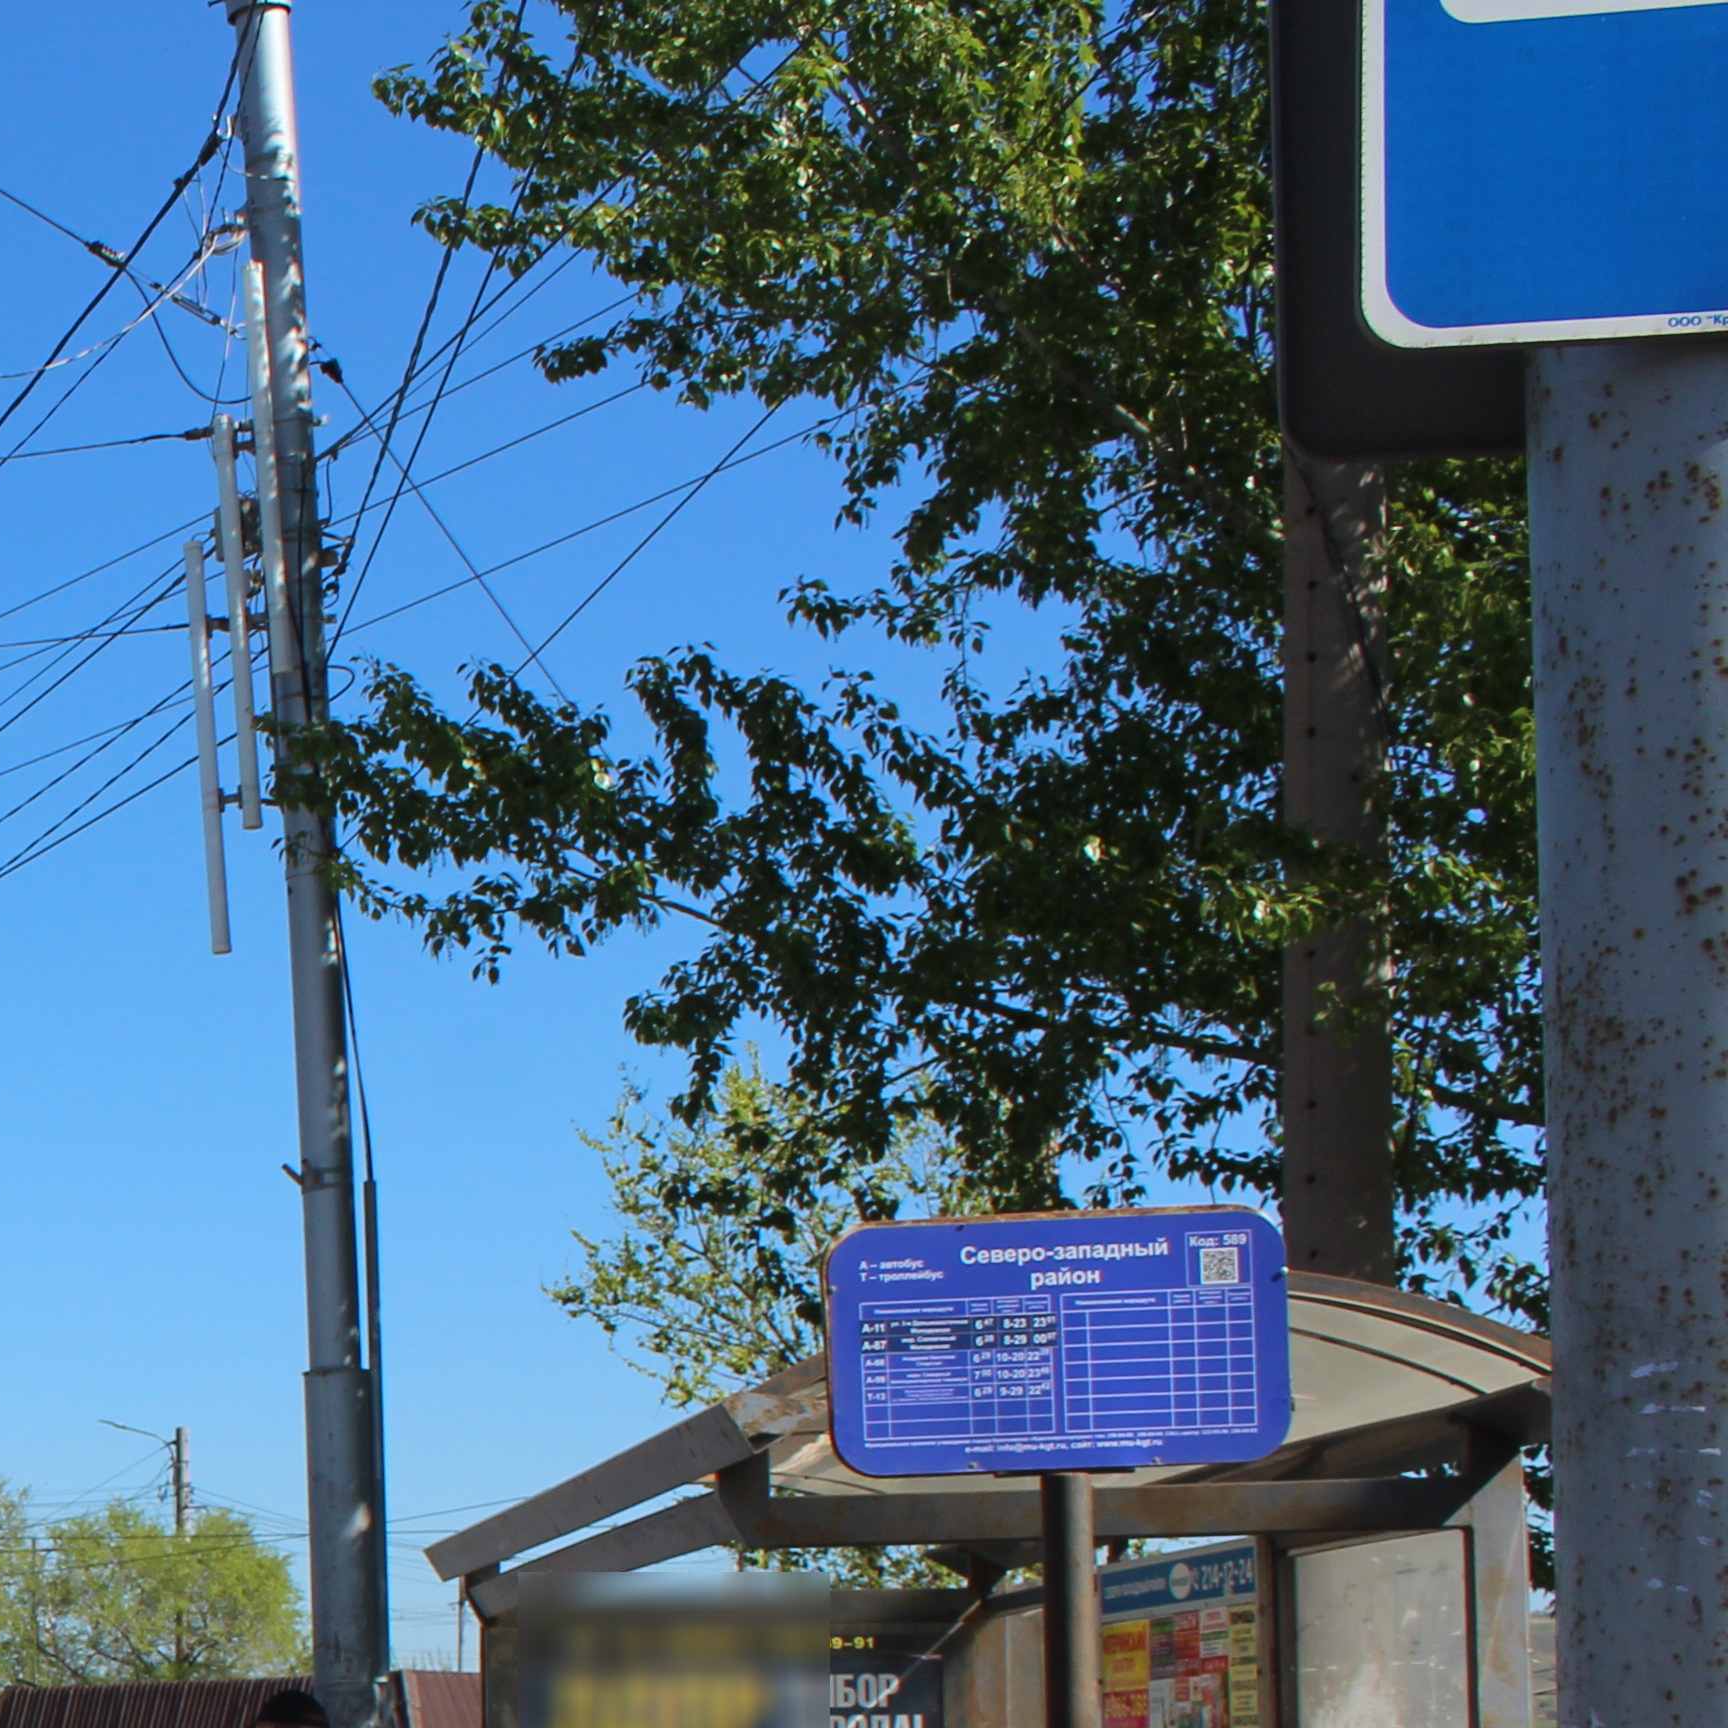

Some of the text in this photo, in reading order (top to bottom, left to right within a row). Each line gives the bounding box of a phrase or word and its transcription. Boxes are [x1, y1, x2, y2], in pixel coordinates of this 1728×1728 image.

[1189, 1233, 1248, 1248] Код: 589
[960, 1237, 1169, 1266] Северо-западный
[879, 1258, 924, 1270] автобус
[879, 1269, 944, 1282] троллейбус
[1030, 1267, 1101, 1290] район
[829, 1673, 899, 1708] БОР
